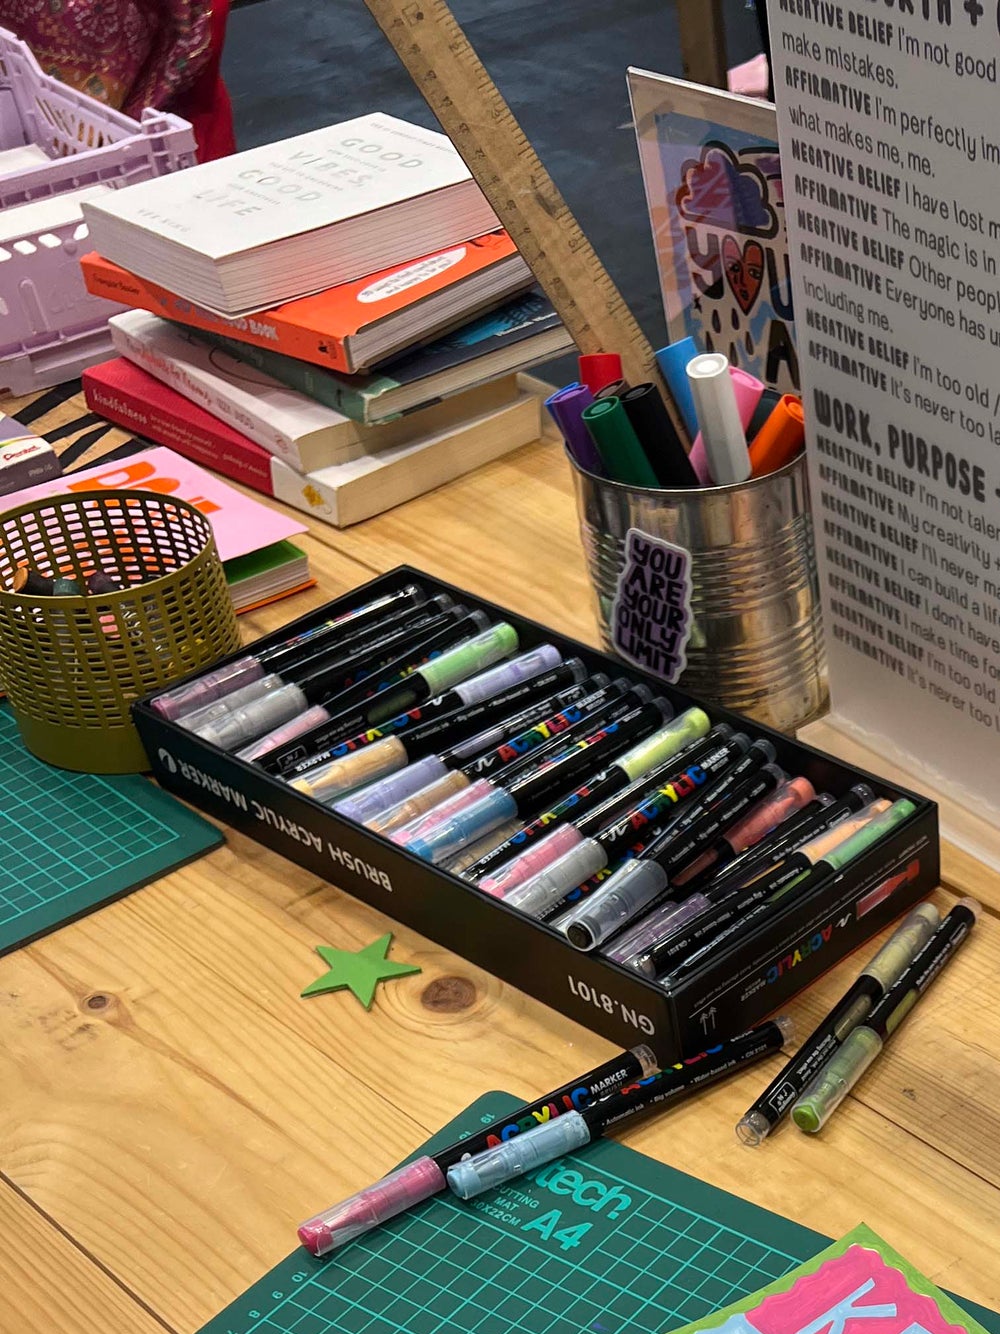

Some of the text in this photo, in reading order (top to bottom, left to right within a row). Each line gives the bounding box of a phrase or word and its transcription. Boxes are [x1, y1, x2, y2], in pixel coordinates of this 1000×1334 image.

[781, 31, 898, 88] make mistakes.
[848, 11, 893, 46] BELIEF
[897, 26, 920, 57] I'm
[923, 41, 950, 68] not
[954, 51, 996, 83] good
[785, 65, 871, 115] AFFIRMATIVE
[874, 95, 896, 126] I'm
[899, 111, 976, 161] perfectly
[788, 104, 935, 178] what makes me, me.
[340, 138, 424, 169] GOOD
[193, 189, 262, 217] LIFE
[238, 169, 321, 202] GOOD
[791, 138, 853, 181] NEGATIVE
[857, 163, 900, 199] BELIEF
[912, 184, 949, 219] have
[952, 199, 984, 234] lost
[794, 173, 877, 225] AFFIRMATIVE
[881, 207, 910, 240] The
[914, 227, 960, 260] magic
[963, 241, 978, 267] is
[982, 249, 996, 275] in
[796, 208, 858, 251] NEGATIVE
[861, 235, 904, 270] BELIEF
[908, 254, 952, 291] Other
[799, 242, 881, 294] AFFIRMATIVE
[885, 277, 955, 327] Everyone
[958, 309, 986, 340] has
[802, 275, 893, 333] including me.
[805, 307, 864, 350] NEGATIVE
[867, 336, 909, 370] BELIEF
[912, 355, 933, 383] I'm
[935, 367, 961, 395] too
[964, 383, 989, 408] old
[808, 340, 886, 391] AFFIRMATIVE
[890, 376, 911, 404] It's
[914, 393, 955, 423] never
[959, 410, 985, 438] too
[812, 388, 880, 454] WORK,
[887, 424, 985, 502] PURPOSE
[630, 565, 683, 606] ARE
[633, 538, 682, 579] YOU
[619, 606, 678, 653] ONLY
[624, 584, 684, 632] YOUR
[618, 626, 677, 675] LIMIT
[181, 759, 392, 892] BRUSH ACRYLIC MARKER
[629, 765, 707, 830] ACRYLIC
[766, 924, 833, 985] ACRYLIC
[567, 975, 655, 1036] GN.8101
[590, 1068, 628, 1095] MARKER
[494, 1197, 520, 1212] MAT
[520, 1209, 593, 1251] A4
